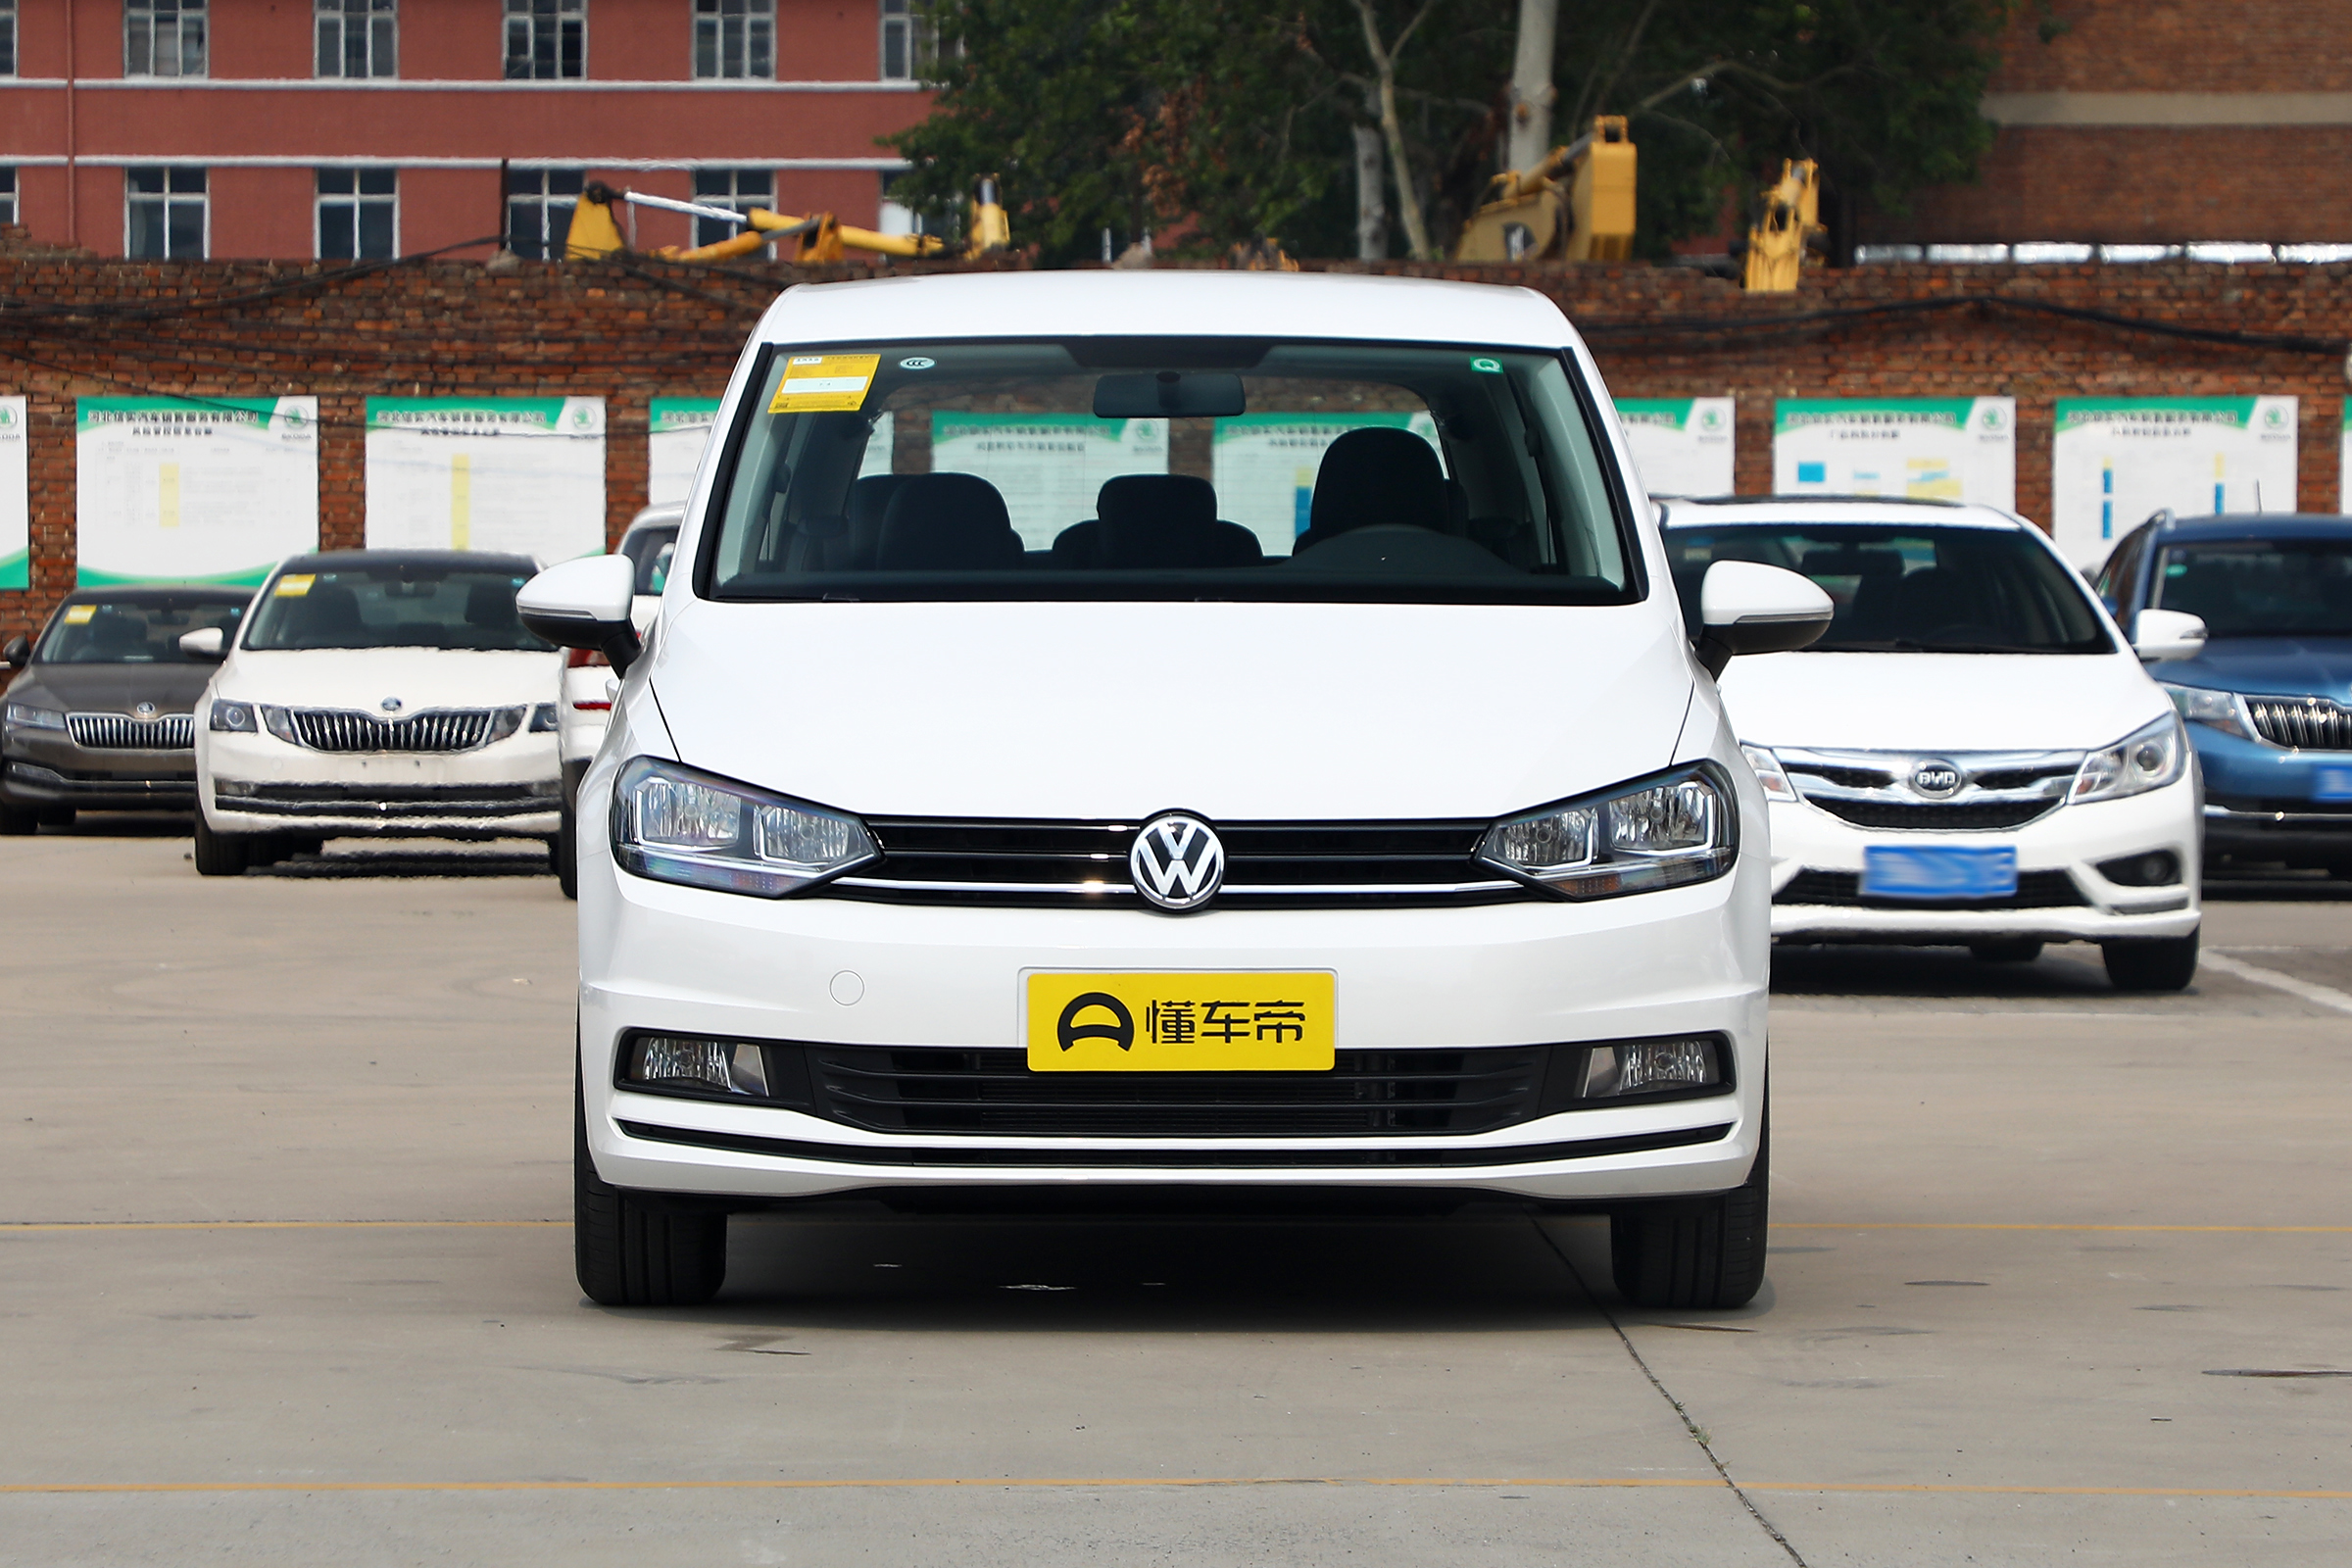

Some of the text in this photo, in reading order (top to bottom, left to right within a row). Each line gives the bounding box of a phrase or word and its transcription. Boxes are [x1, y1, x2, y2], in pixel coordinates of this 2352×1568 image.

[1919, 770, 1956, 785] BYD
[1145, 999, 1306, 1045] 懂车帝
